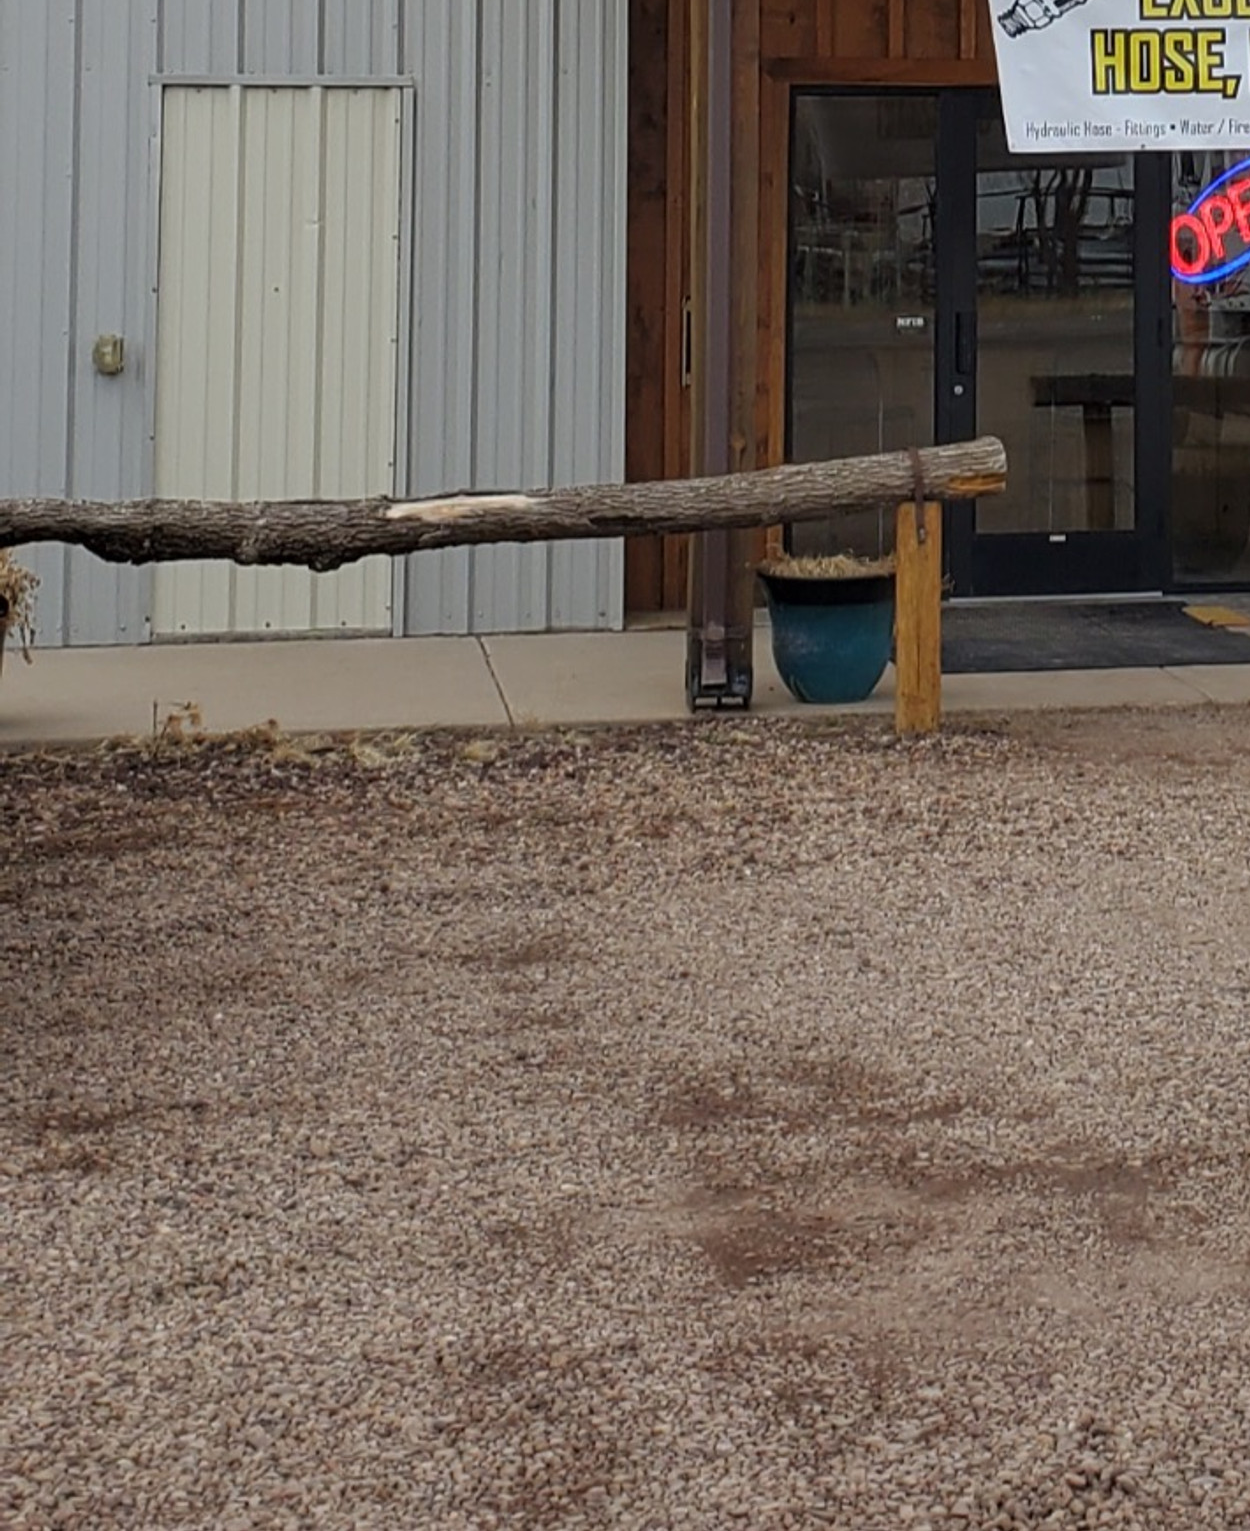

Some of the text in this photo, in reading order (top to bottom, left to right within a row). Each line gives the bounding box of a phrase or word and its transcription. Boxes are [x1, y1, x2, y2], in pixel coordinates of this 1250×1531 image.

[1090, 27, 1242, 99] HOSE,
[1026, 121, 1081, 141] Hydraulic
[1083, 121, 1113, 137] Hose
[1124, 120, 1167, 138] Fittings
[1180, 119, 1214, 135] Water
[1228, 118, 1250, 134] Fire
